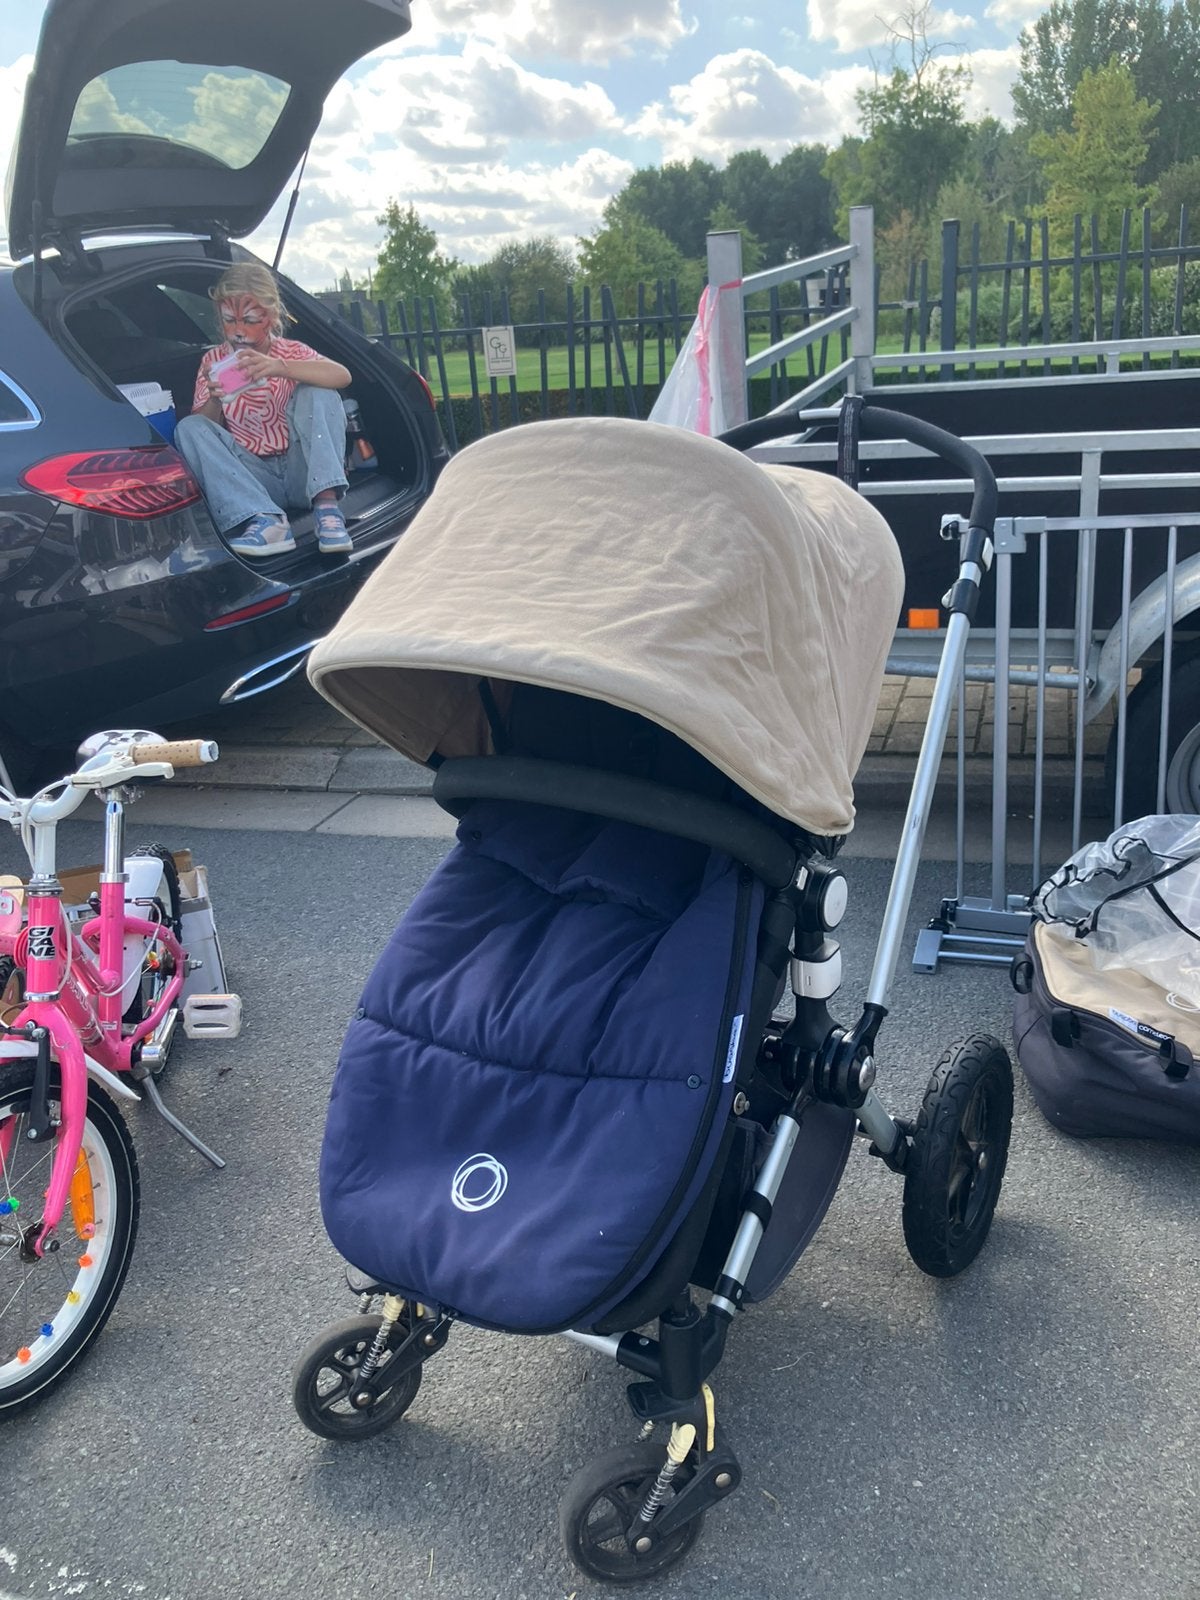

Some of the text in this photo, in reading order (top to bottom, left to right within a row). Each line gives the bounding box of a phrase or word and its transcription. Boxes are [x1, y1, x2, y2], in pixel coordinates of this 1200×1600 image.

[29, 927, 54, 936] GI
[29, 937, 53, 946] TA
[28, 946, 55, 956] NE
